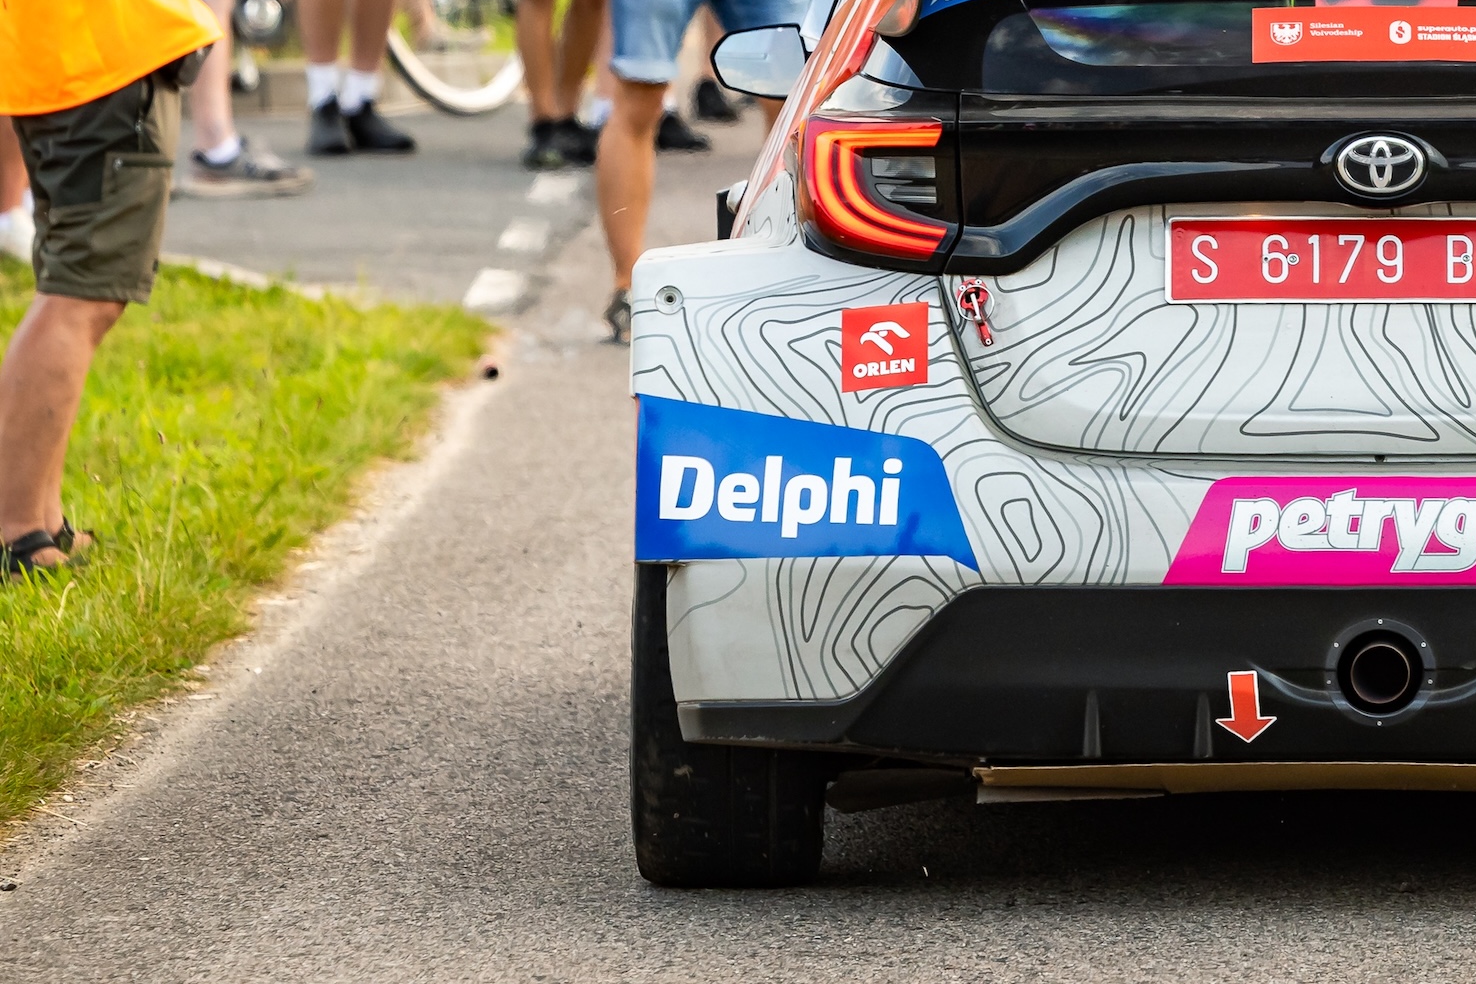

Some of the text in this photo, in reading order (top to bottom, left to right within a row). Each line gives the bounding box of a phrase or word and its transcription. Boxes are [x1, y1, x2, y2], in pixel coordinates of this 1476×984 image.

[1310, 29, 1363, 37] Voivodeship
[1417, 33, 1452, 41] STADION
[1191, 234, 1219, 284] S
[1261, 234, 1404, 284] 6179
[853, 357, 915, 378] ORLEN
[659, 455, 903, 538] Delphi
